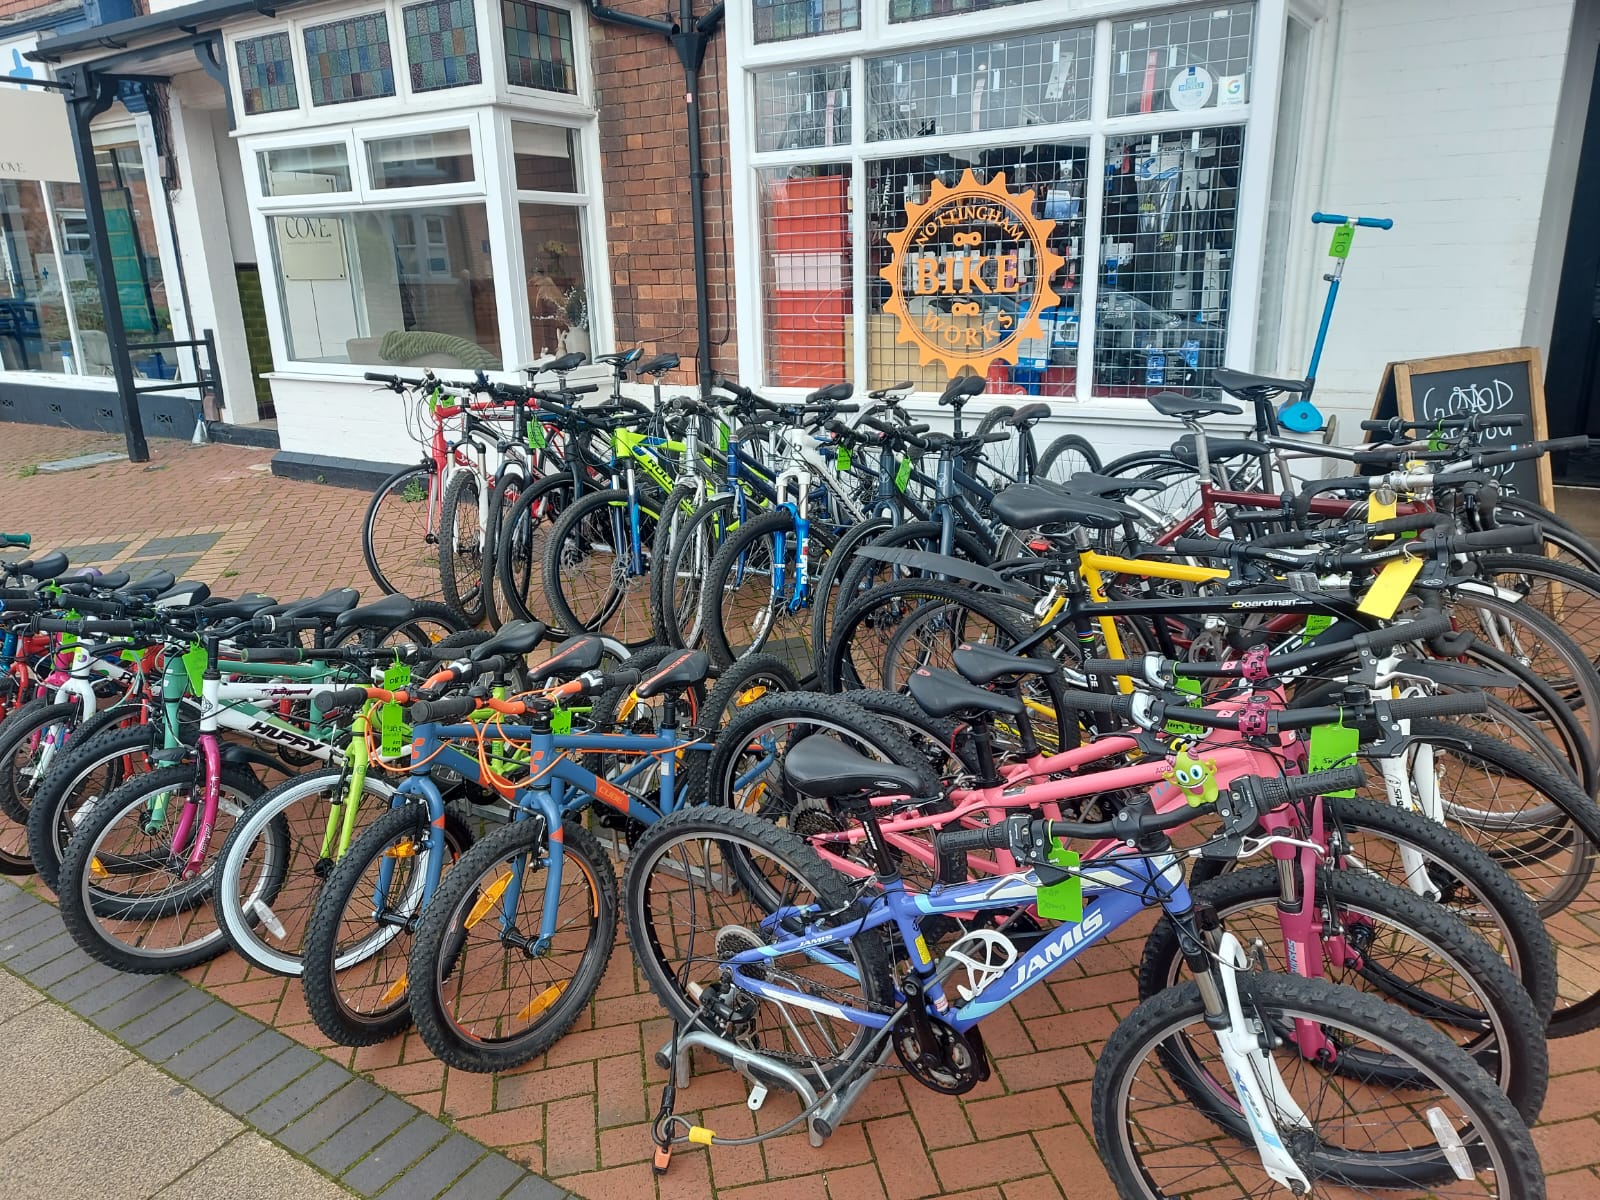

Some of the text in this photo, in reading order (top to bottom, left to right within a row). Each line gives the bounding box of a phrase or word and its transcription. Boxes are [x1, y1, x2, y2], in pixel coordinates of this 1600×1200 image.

[285, 217, 332, 239] COVE.
[915, 205, 1025, 248] NOTTINGHAM
[915, 254, 1019, 295] BIKE
[924, 309, 1013, 347] WORKS
[247, 721, 326, 752] HUFFY
[798, 933, 833, 947] JAMIS
[1010, 908, 1104, 990] JAMIS
